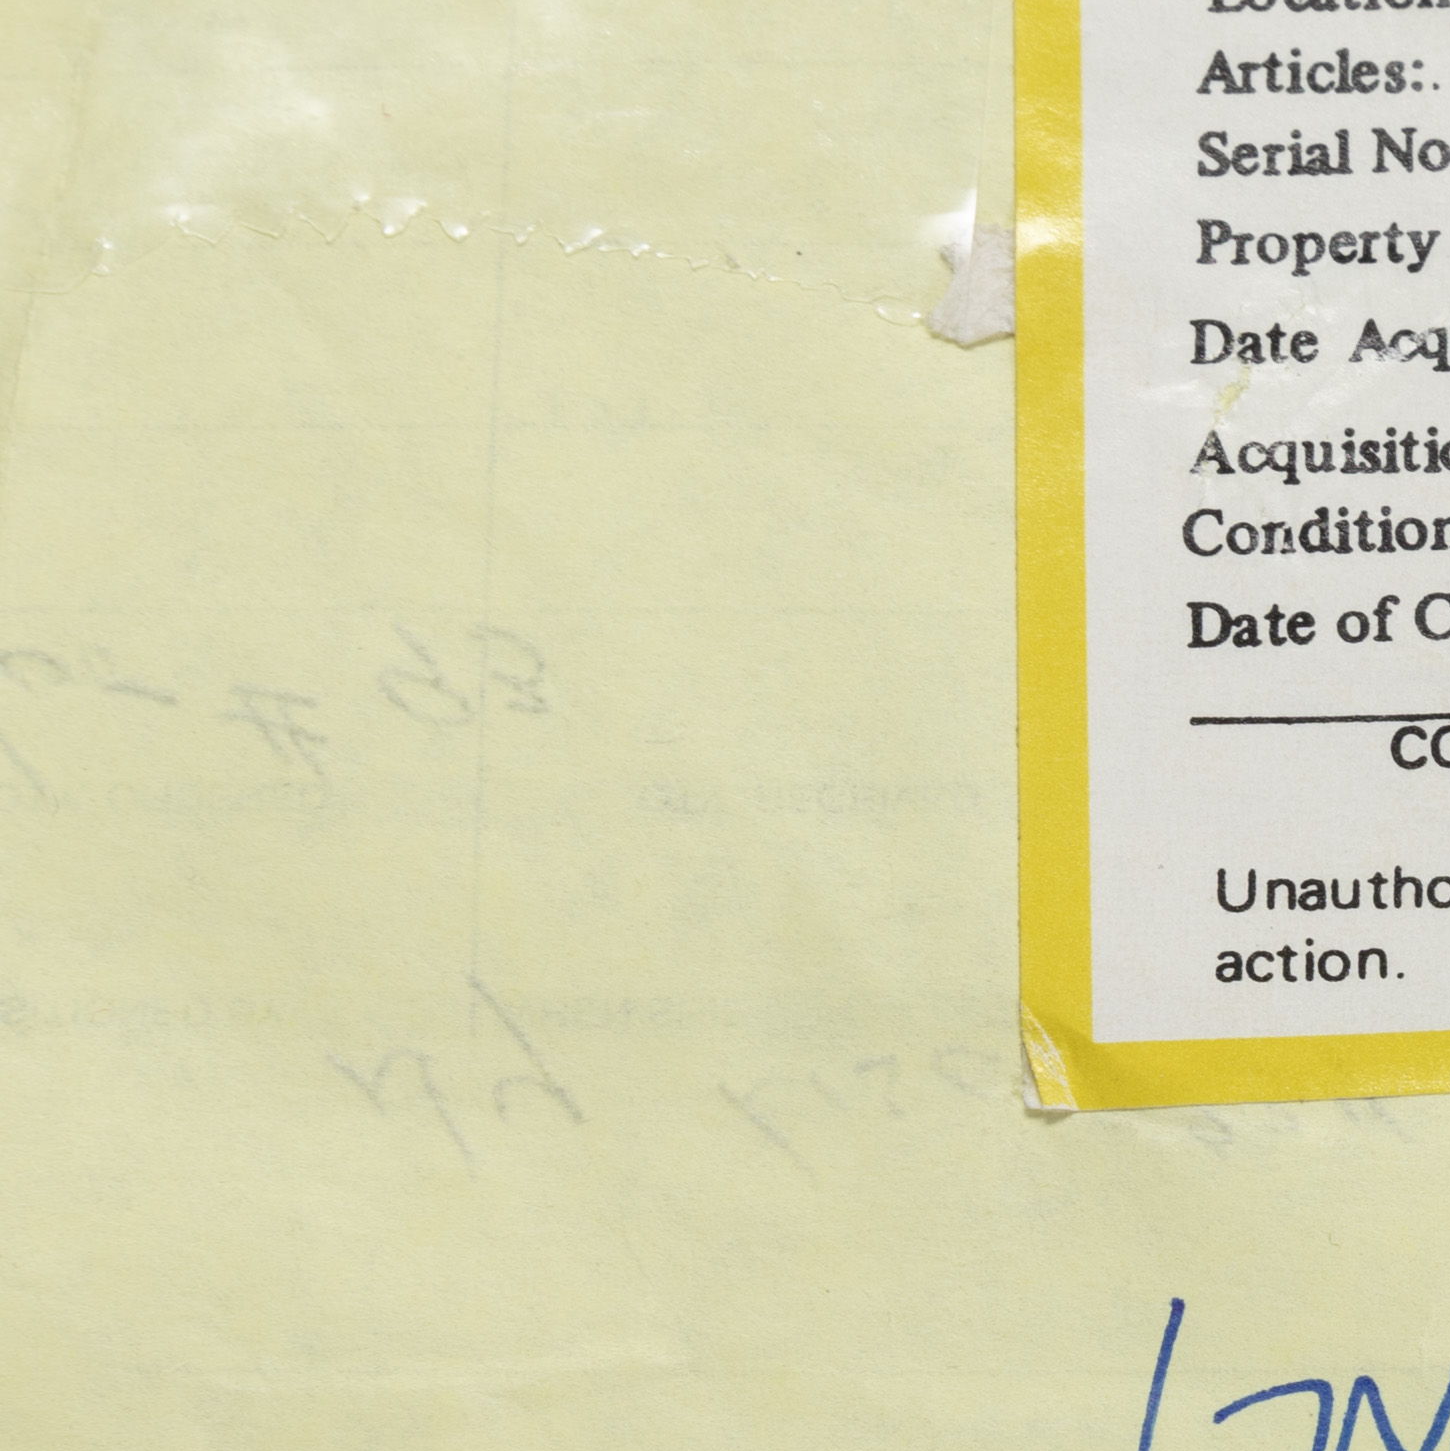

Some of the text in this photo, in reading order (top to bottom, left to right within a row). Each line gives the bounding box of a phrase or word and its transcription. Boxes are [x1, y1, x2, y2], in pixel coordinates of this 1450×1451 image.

[1198, 129, 1352, 176] Serial
[1197, 220, 1440, 276] Property
[1190, 319, 1318, 364] Date
[1187, 602, 1315, 648] Date
[1337, 595, 1400, 643] of
[1216, 938, 1404, 982] action.
